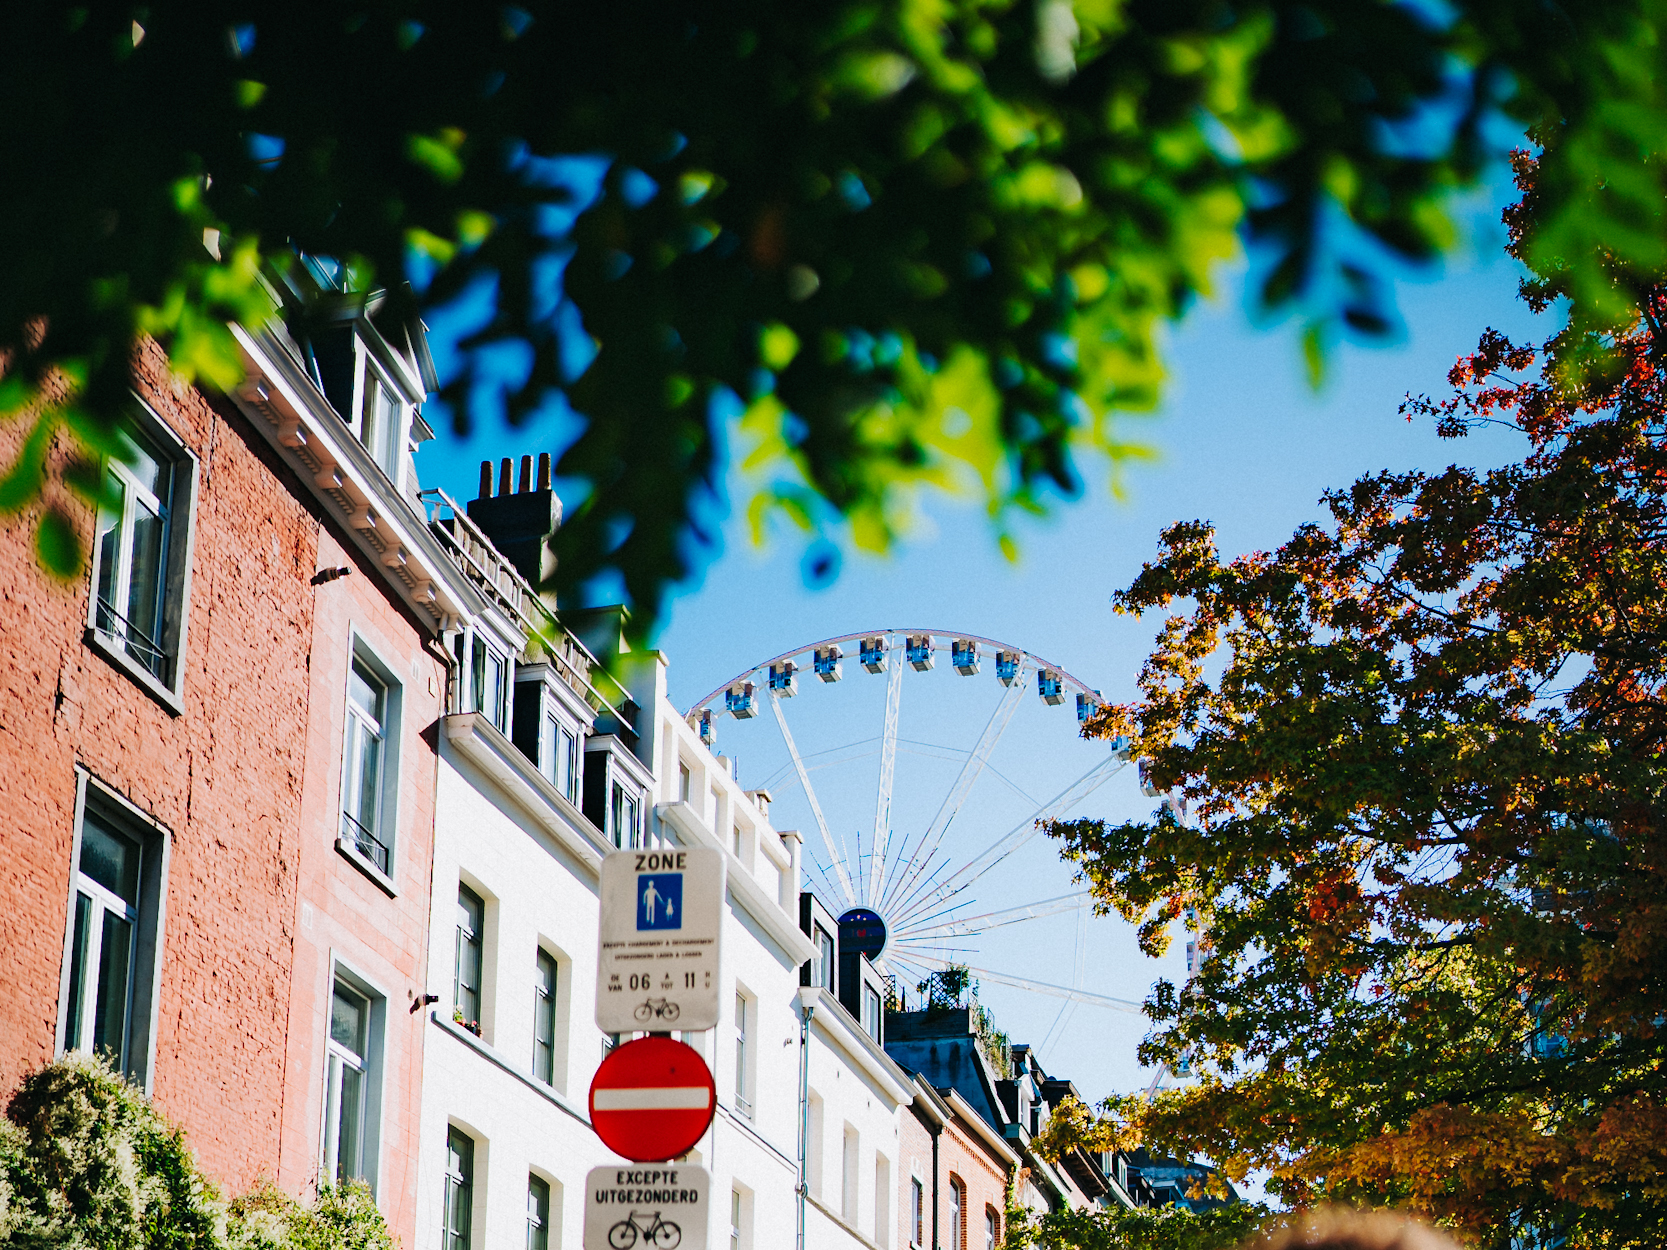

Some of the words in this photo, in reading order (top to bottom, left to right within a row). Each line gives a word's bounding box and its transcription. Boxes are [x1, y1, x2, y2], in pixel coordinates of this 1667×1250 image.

[635, 853, 687, 872] ZONE
[608, 984, 623, 992] VAN
[661, 981, 673, 990] TOT
[629, 973, 650, 991] 06
[684, 971, 696, 989] 11
[616, 1170, 679, 1186] EXCEPTE
[595, 1189, 699, 1204] UITGEZONDERD
